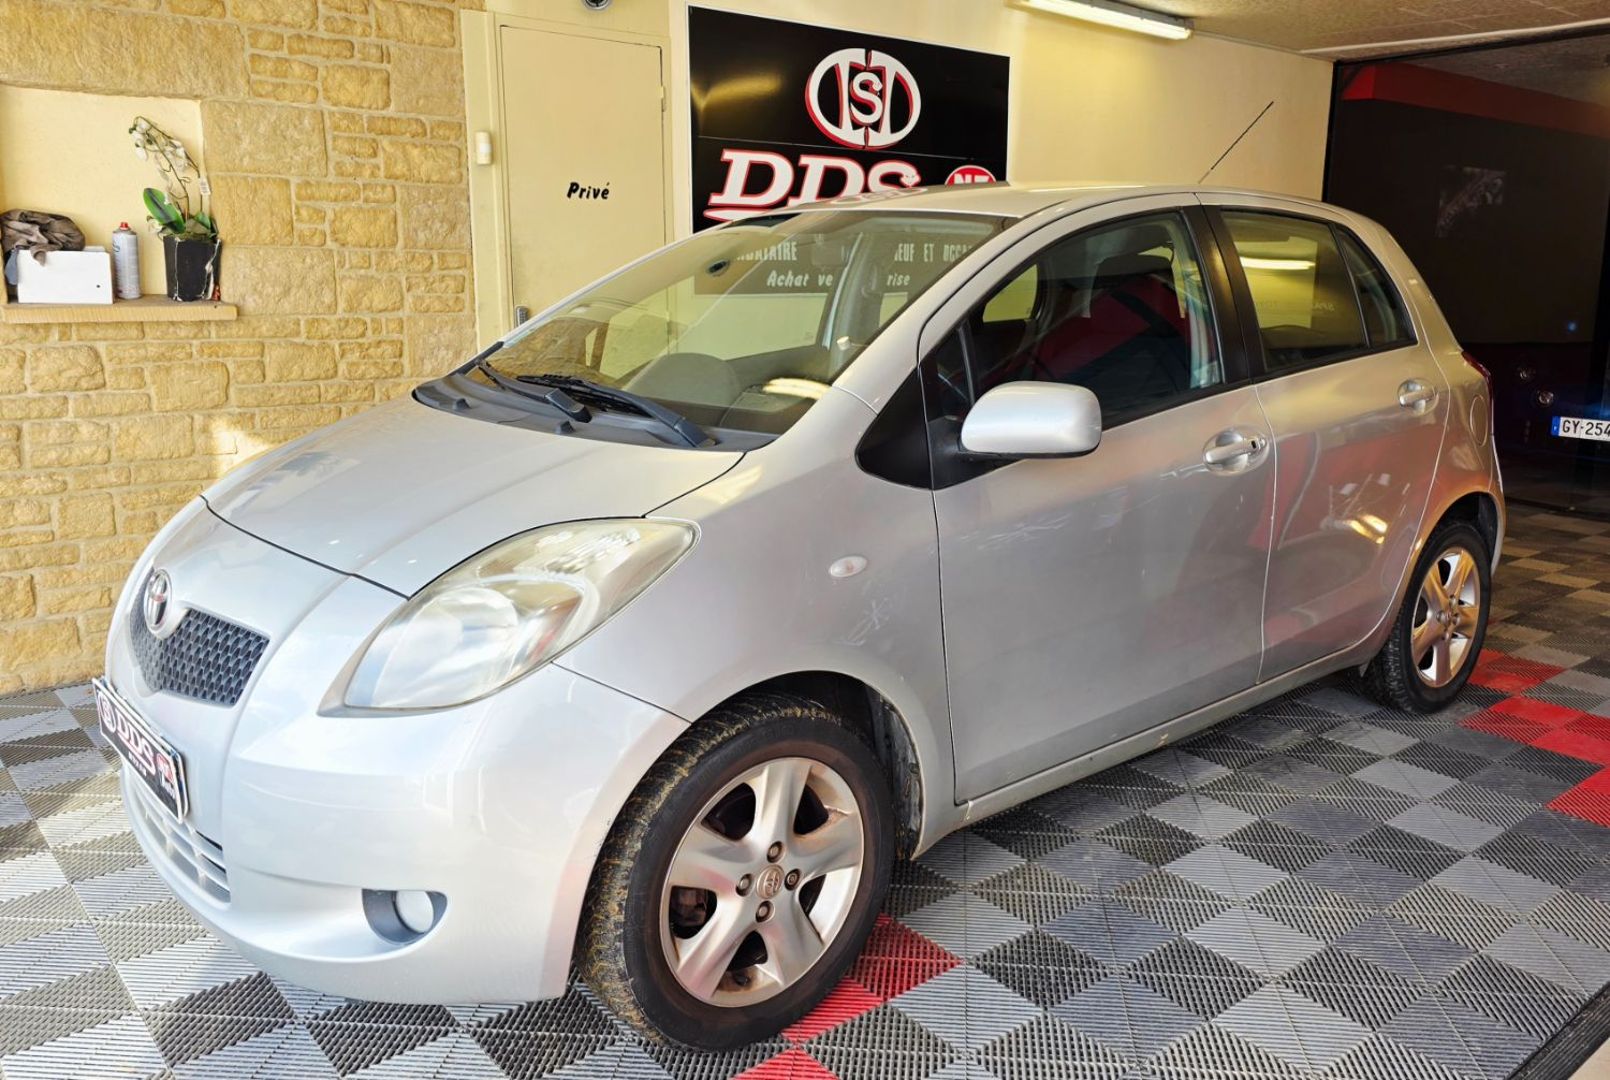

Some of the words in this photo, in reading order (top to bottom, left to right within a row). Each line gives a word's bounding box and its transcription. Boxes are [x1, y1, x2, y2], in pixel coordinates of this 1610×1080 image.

[566, 181, 610, 200] Privé
[923, 243, 935, 262] ET
[766, 269, 809, 287] Achat
[886, 273, 910, 287] rise
